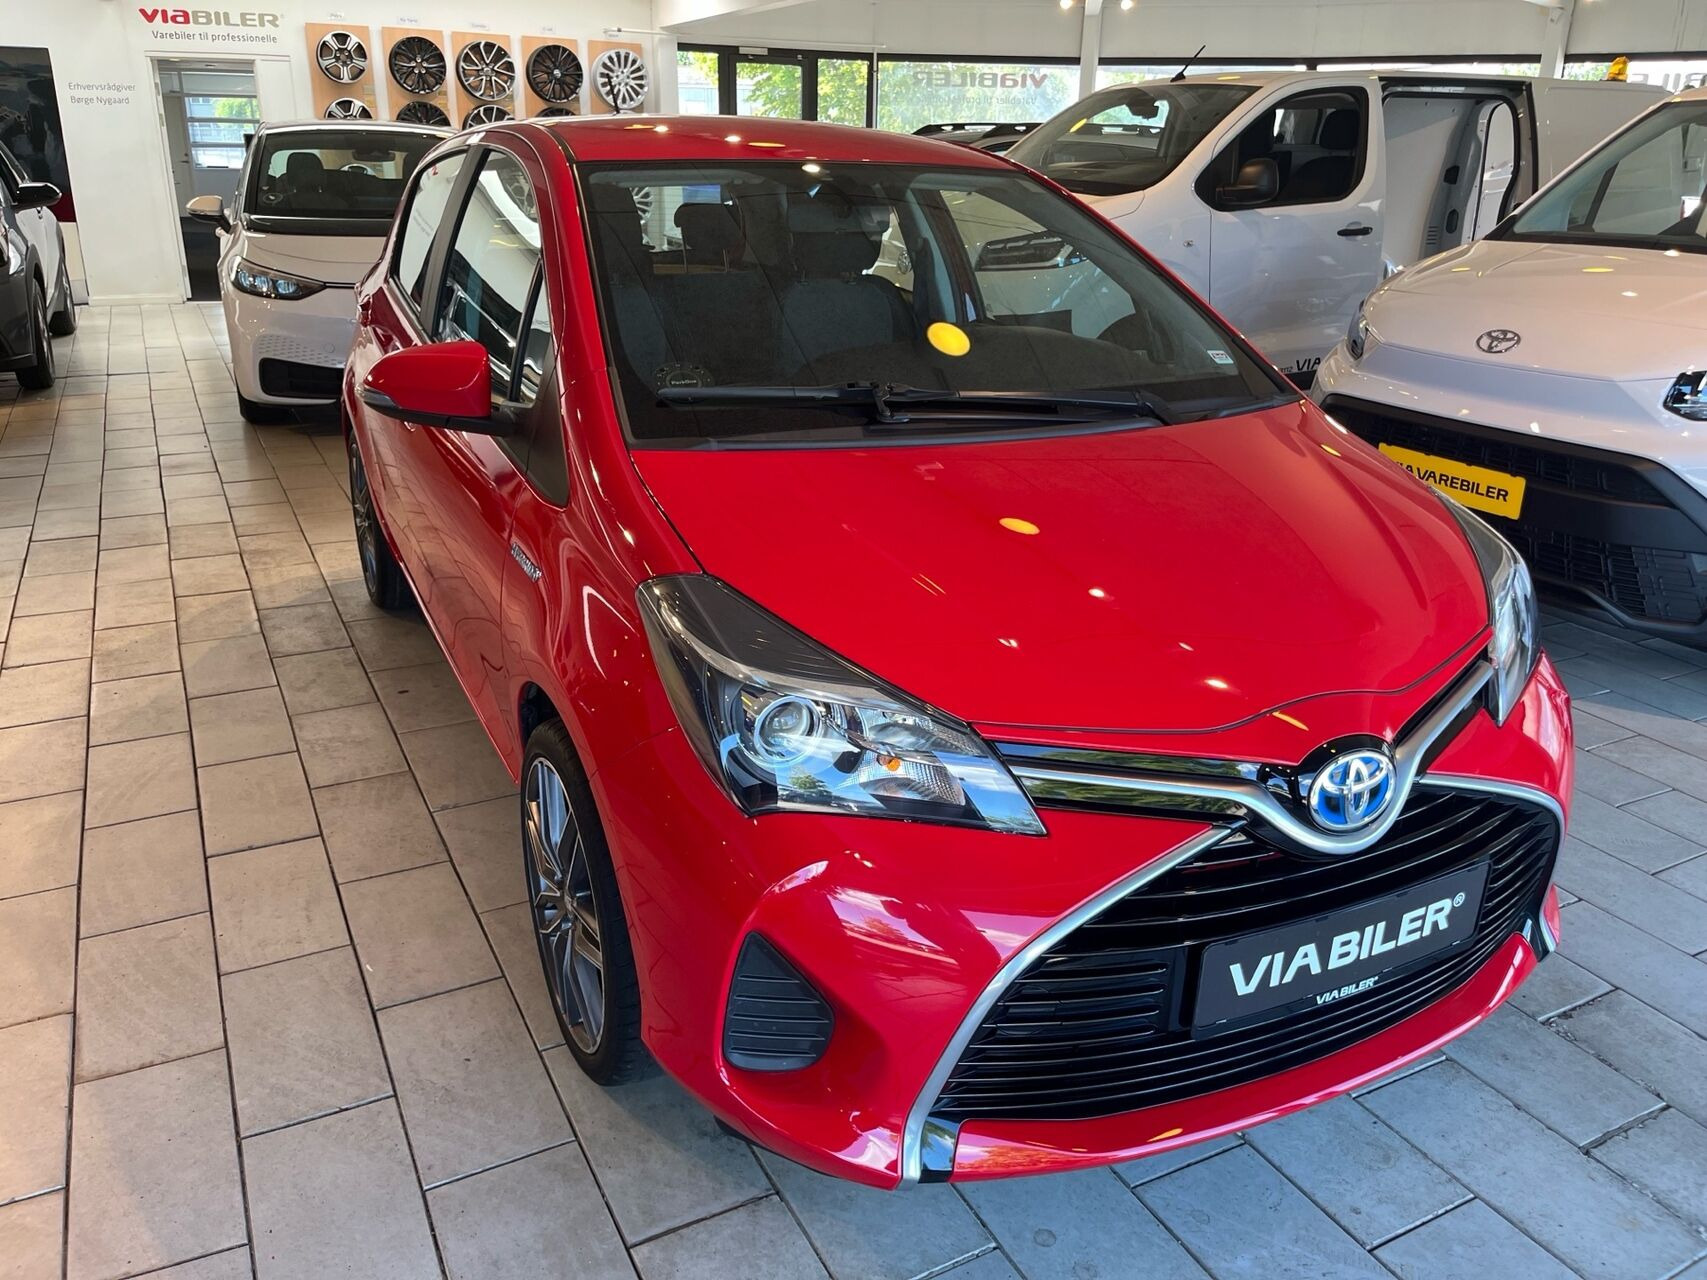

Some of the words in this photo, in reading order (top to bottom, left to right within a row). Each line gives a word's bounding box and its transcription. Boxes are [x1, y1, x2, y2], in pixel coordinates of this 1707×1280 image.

[151, 30, 196, 41] Varebiler
[199, 31, 209, 41] til
[211, 32, 278, 43] professionelle
[70, 95, 95, 105] Børge
[96, 96, 131, 106] Nygaard
[1417, 467, 1510, 503] VAREBILER
